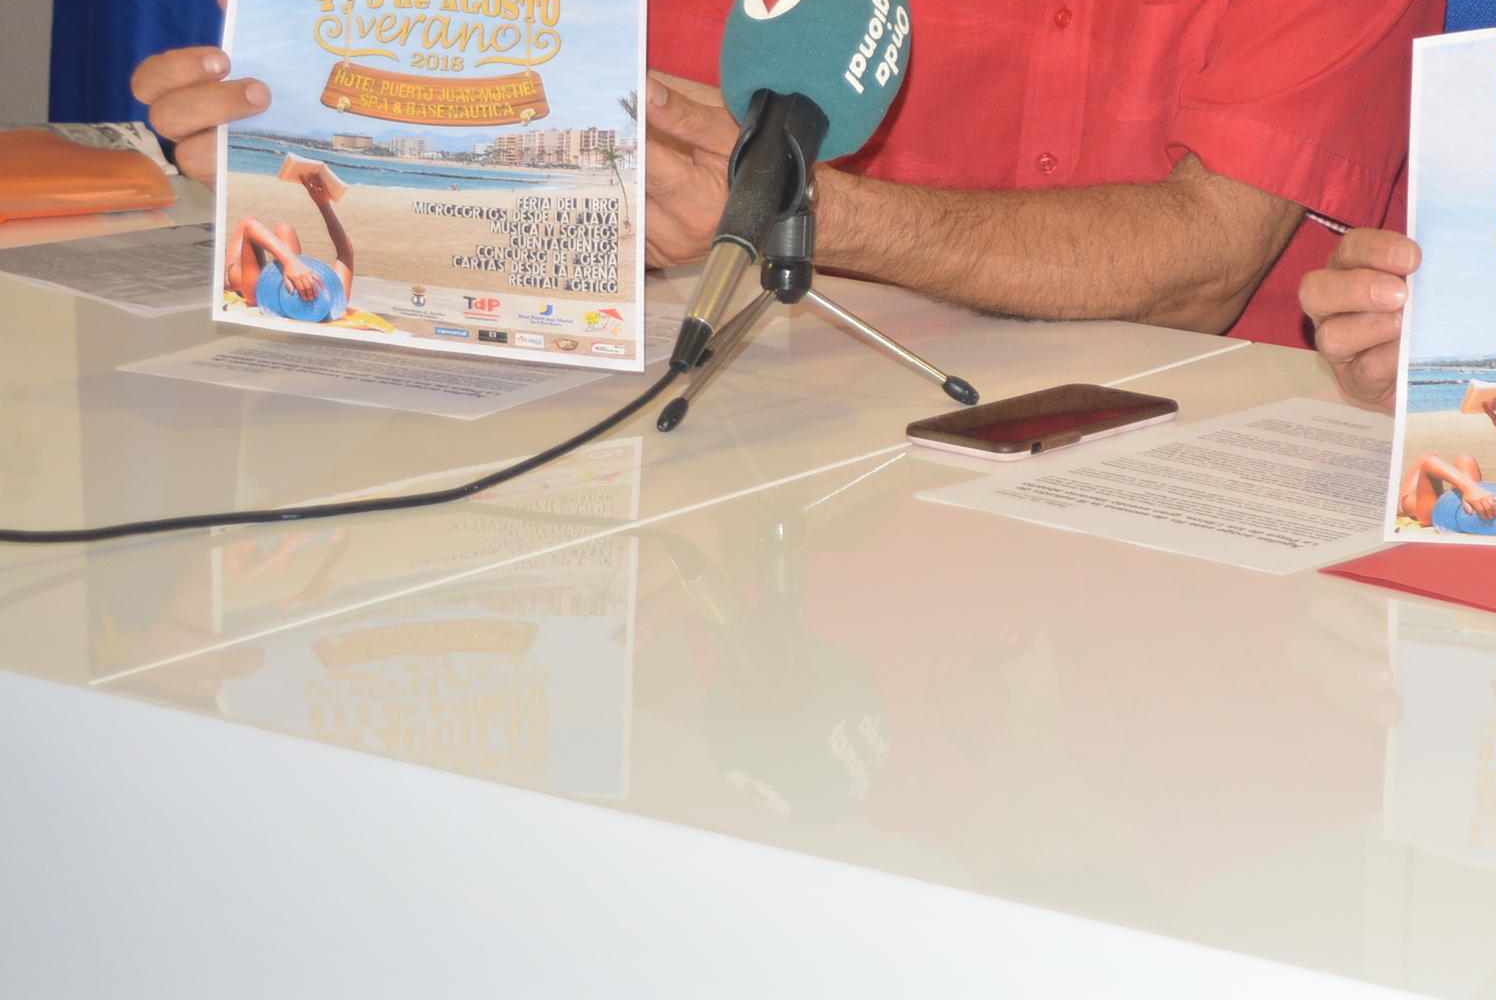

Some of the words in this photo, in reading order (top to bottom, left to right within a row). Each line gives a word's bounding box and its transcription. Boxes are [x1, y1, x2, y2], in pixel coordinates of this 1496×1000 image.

[355, 12, 521, 52] verano
[874, 5, 910, 88] Onda
[410, 52, 465, 72] 2018
[334, 69, 376, 93] HOTEL
[380, 80, 434, 101] PUERTO
[438, 87, 476, 103] JUAN
[478, 79, 539, 103] MONTIEL
[359, 93, 389, 112] SPA
[405, 102, 445, 118] BASE
[412, 201, 508, 221] MICROCORTOS
[513, 209, 549, 224] DESDE
[554, 211, 570, 225] LA
[516, 196, 551, 210] FERIA
[557, 198, 577, 211] DEL
[582, 198, 619, 212] LIBRO
[544, 224, 554, 237] Y
[559, 225, 619, 240] SORTEOS
[509, 234, 619, 253] CUENTACUENTOS
[476, 244, 547, 263] CONCURSO
[553, 251, 567, 265] DE
[452, 255, 505, 273] CARTAS
[511, 261, 547, 276] DESDE
[552, 264, 568, 278] LA
[574, 265, 619, 280] ARENA
[508, 273, 559, 290] RECITAL
[463, 296, 501, 312] TdP
